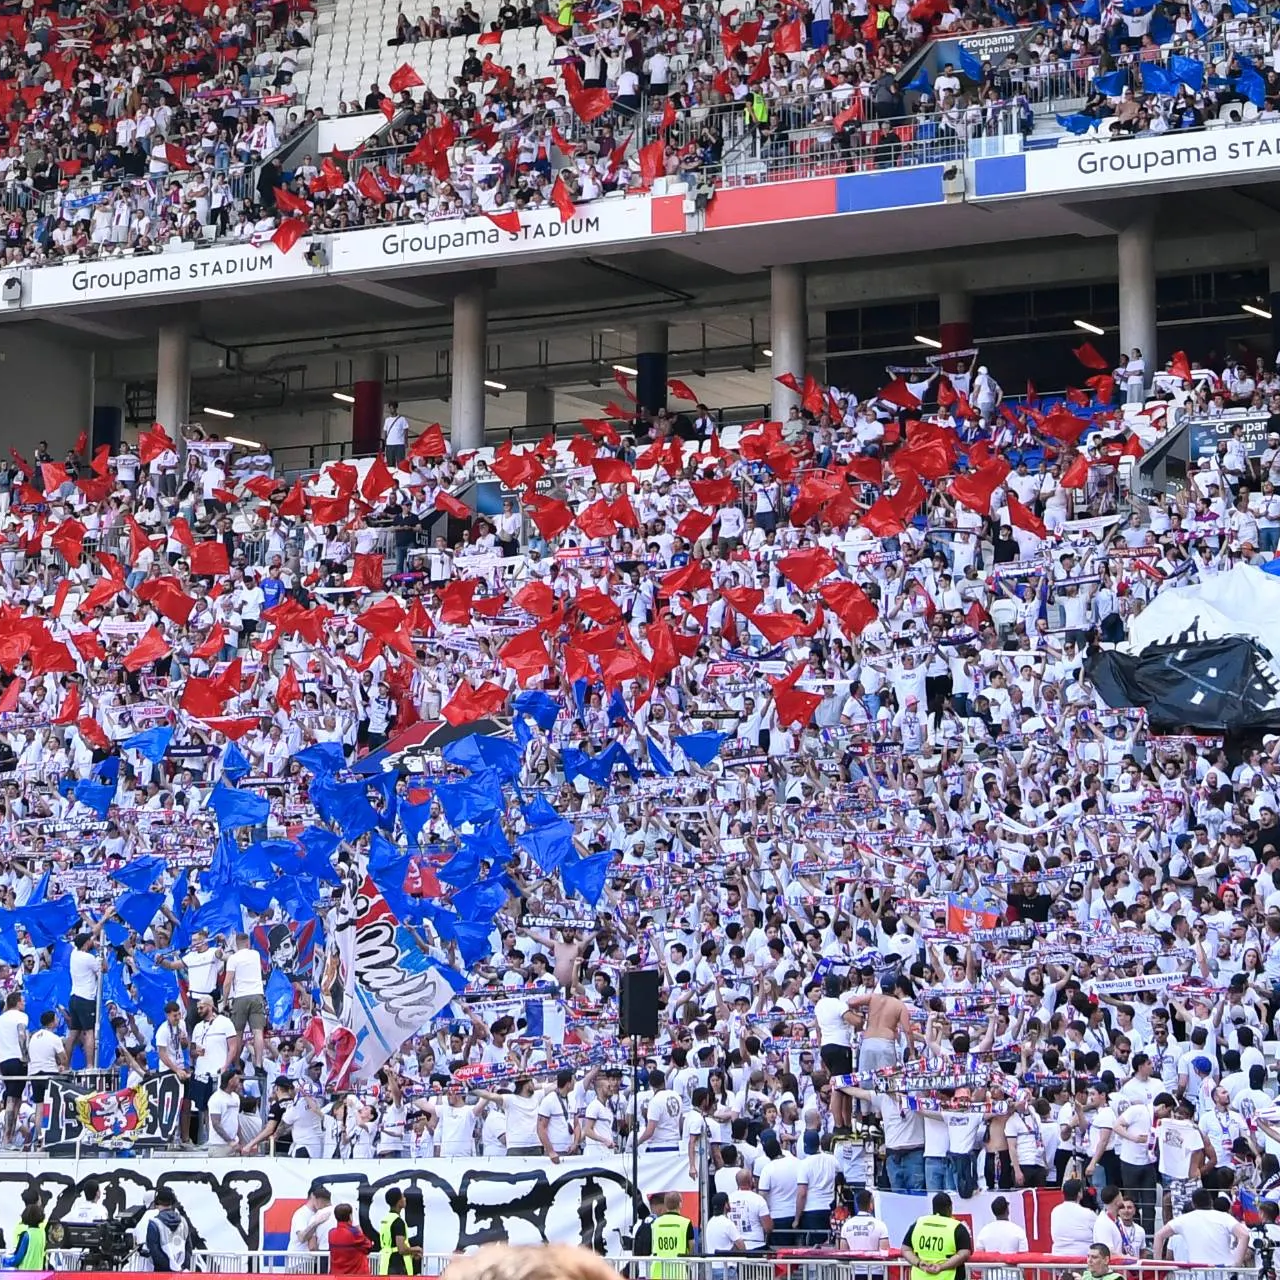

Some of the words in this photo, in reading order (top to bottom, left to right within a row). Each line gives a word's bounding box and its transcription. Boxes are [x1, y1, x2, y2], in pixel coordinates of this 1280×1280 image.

[958, 34, 1015, 49] Groupama
[979, 45, 1015, 55] STADIUM
[1077, 144, 1217, 174] Groupama
[382, 228, 499, 255] Groupama
[509, 216, 600, 242] STADIUM
[72, 264, 181, 290] Groupama
[189, 255, 273, 279] STADIUM
[918, 1235, 944, 1253] 0470
